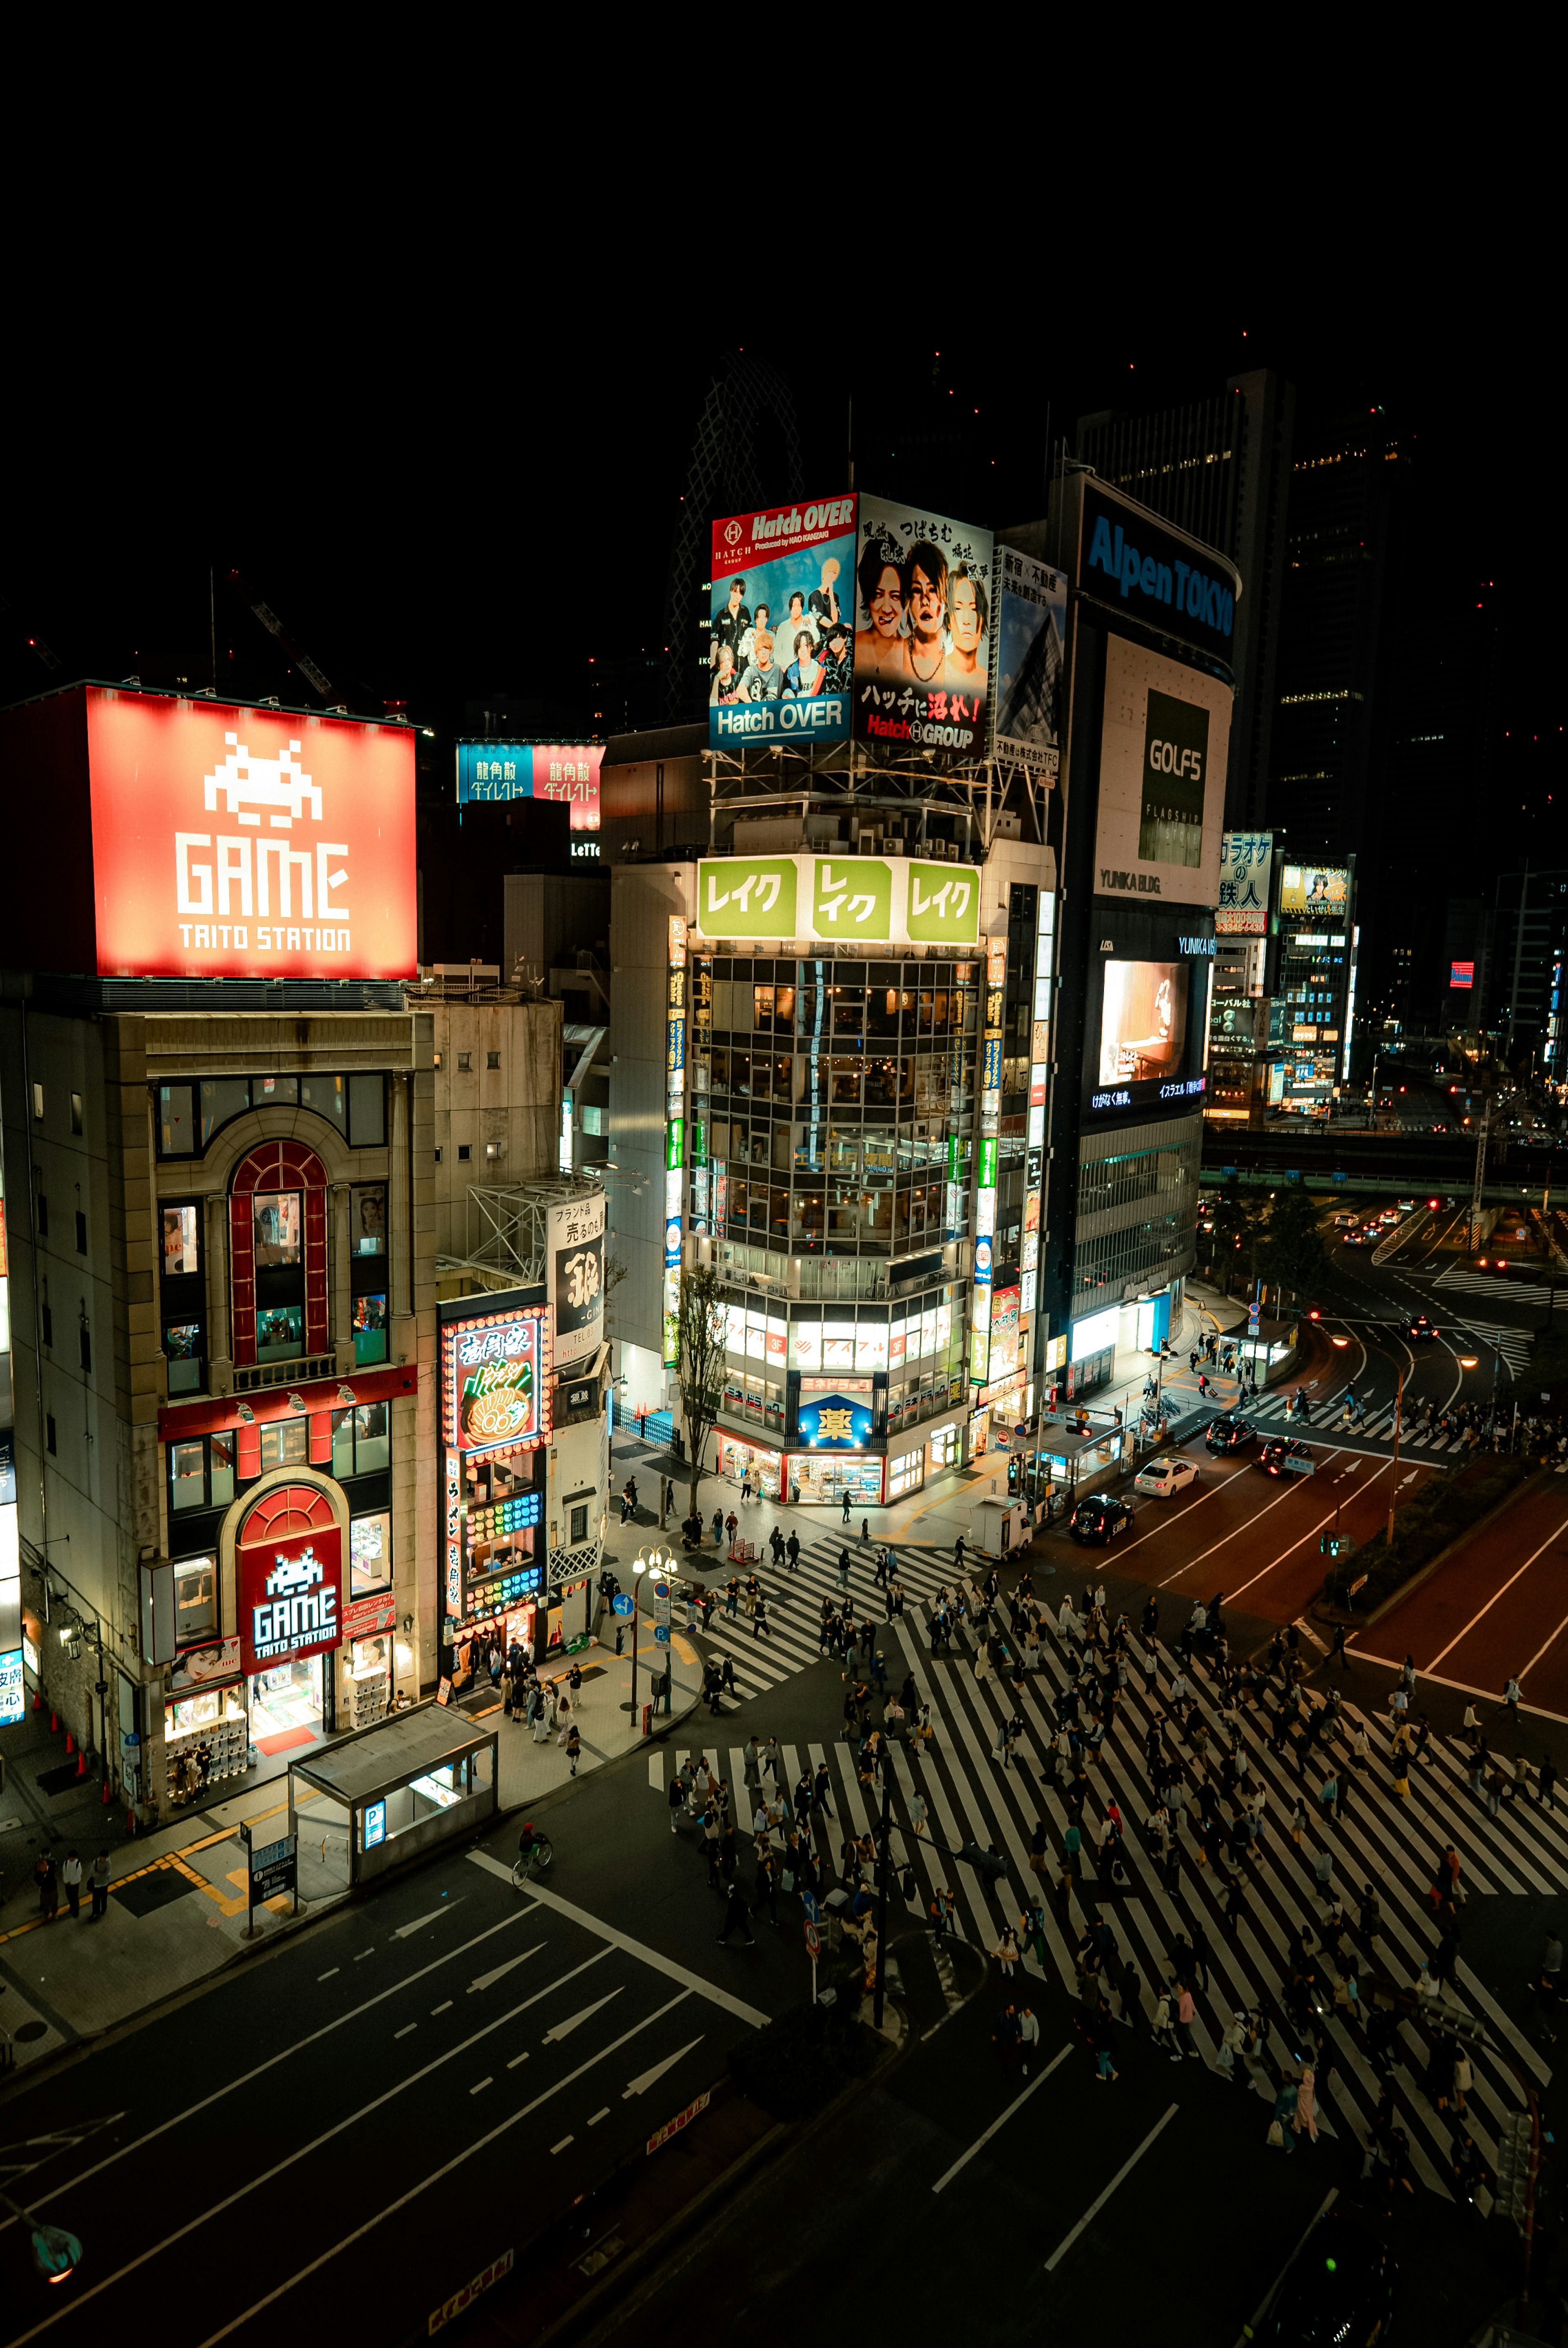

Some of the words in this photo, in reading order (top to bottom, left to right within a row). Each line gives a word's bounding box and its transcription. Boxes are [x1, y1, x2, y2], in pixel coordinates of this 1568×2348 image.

[752, 508, 802, 540] Hatch
[804, 499, 853, 531] OVER
[715, 546, 751, 560] HATCH
[755, 540, 781, 550] Produced
[782, 539, 788, 547] by
[789, 535, 802, 544] NAO
[803, 531, 829, 542] KANZAKI
[1088, 515, 1172, 604] Alpen
[1174, 560, 1233, 637] TOKYO
[718, 707, 774, 734] Hatch
[780, 700, 842, 729] OVER
[867, 714, 910, 739] Hatch
[923, 724, 973, 749] GROUP
[477, 761, 516, 780] 龍角散
[550, 762, 590, 781] 龍角散
[1150, 739, 1201, 780] GOLF5
[1147, 804, 1198, 825] FLAGSHIP
[175, 832, 350, 919] GAME
[708, 874, 781, 912] レイク
[912, 878, 970, 919] レイク
[1219, 881, 1262, 910] 鉄人
[179, 924, 248, 949] TAITO
[257, 926, 350, 951] STATION
[1179, 937, 1206, 955] YUNIKA
[994, 991, 1002, 1026] Cheese
[1092, 1090, 1131, 1108] けがなく無事。
[1160, 1084, 1185, 1098] イスラエル
[864, 1152, 893, 1167] 夜間
[556, 1202, 591, 1222] ブランド品
[977, 1250, 990, 1263] 薬
[729, 1323, 764, 1342] アイフル
[771, 1338, 781, 1350] 3F
[826, 1340, 884, 1352] アイフル
[893, 1340, 902, 1353] 3F
[924, 1321, 950, 1340] アイフル
[973, 1338, 984, 1370] レイク
[801, 1378, 873, 1391] ミネドラッグ
[905, 1384, 945, 1407] ミネドラッグ
[950, 1380, 961, 1403] 薬
[728, 1386, 780, 1416] ミネドラッグ
[817, 1408, 853, 1440] 薬
[448, 1480, 459, 1538] ラーメン
[449, 1543, 460, 1605] 壱角家
[253, 1585, 336, 1645] GAME
[255, 1639, 288, 1659] TAITO
[290, 1625, 336, 1650] STATION
[657, 1629, 664, 1639] P
[6, 1692, 20, 1706] 心
[9, 1713, 22, 1722] 2F
[369, 1810, 376, 1825] P
